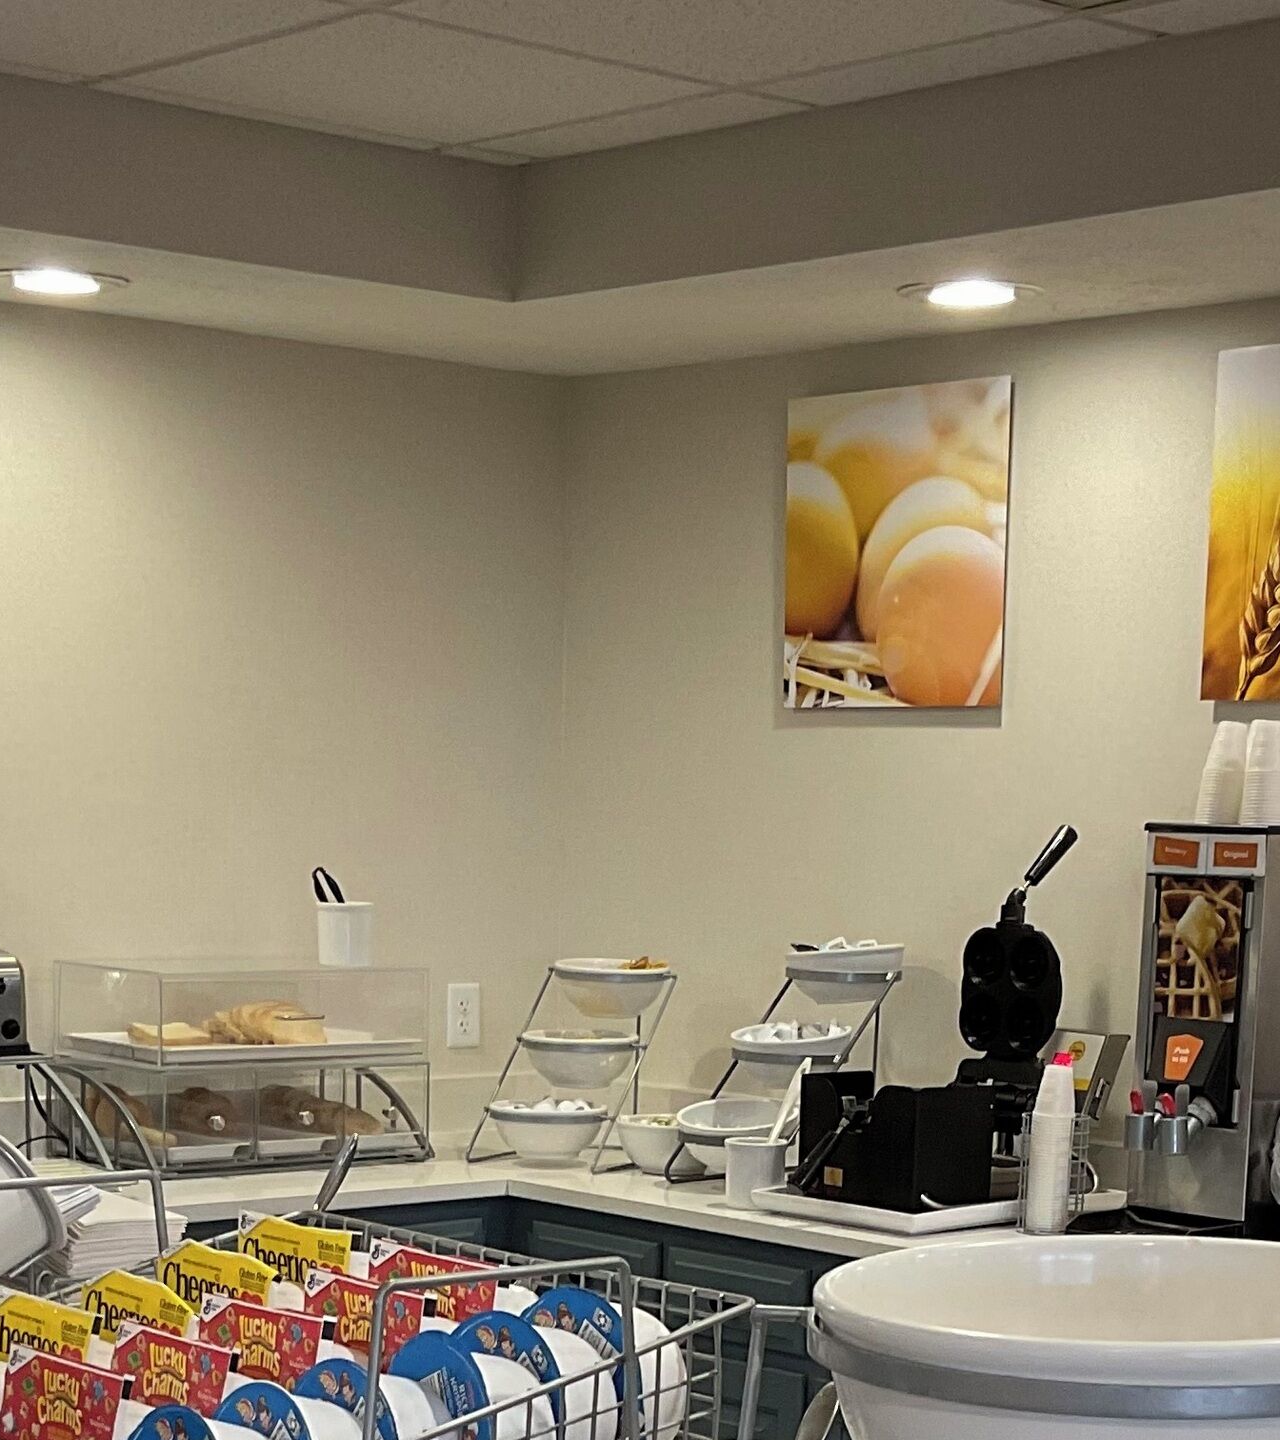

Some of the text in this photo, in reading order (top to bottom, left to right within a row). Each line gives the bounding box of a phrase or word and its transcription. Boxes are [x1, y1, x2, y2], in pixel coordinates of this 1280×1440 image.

[343, 1290, 374, 1318] Luck
[238, 1314, 278, 1350] Lucky
[340, 1316, 371, 1343] Char
[149, 1342, 188, 1381] Lucky
[43, 1368, 80, 1408] Lucky
[142, 1370, 190, 1407] Charms
[37, 1396, 82, 1436] Charms
